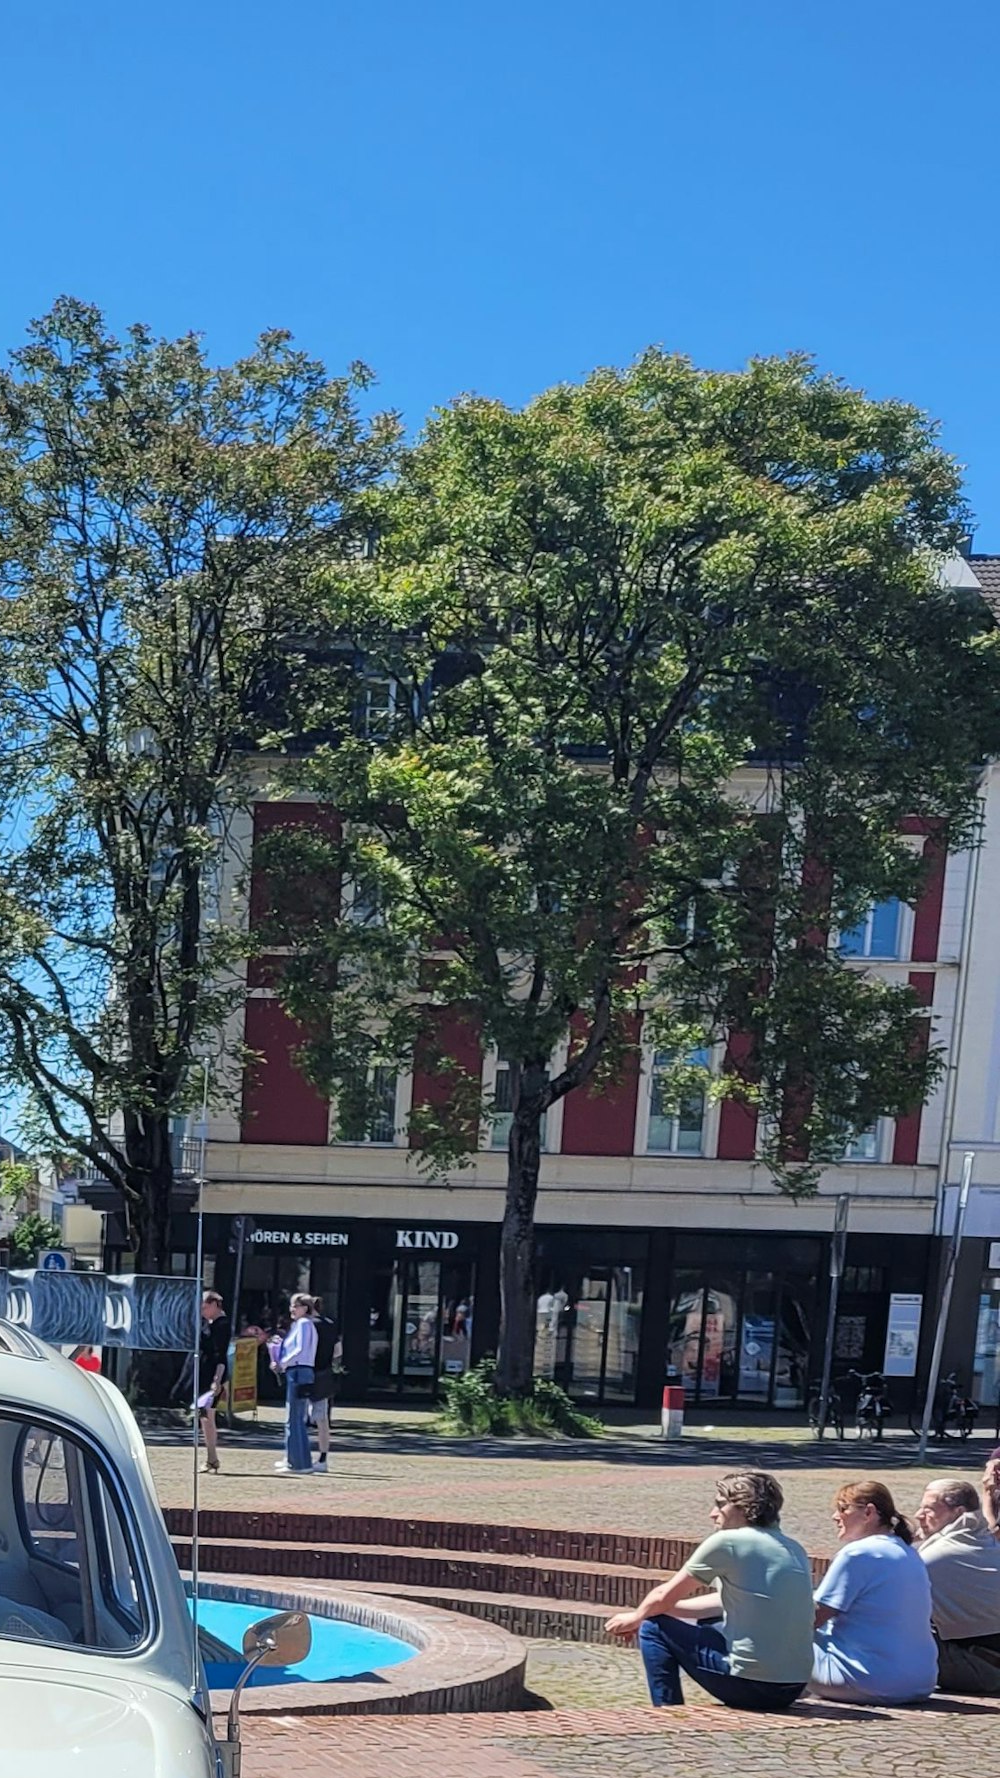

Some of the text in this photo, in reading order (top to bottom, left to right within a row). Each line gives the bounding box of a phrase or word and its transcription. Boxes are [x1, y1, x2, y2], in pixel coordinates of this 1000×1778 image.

[292, 1232, 302, 1244] &
[305, 1232, 349, 1246] SEHEN
[395, 1229, 459, 1249] KIND
